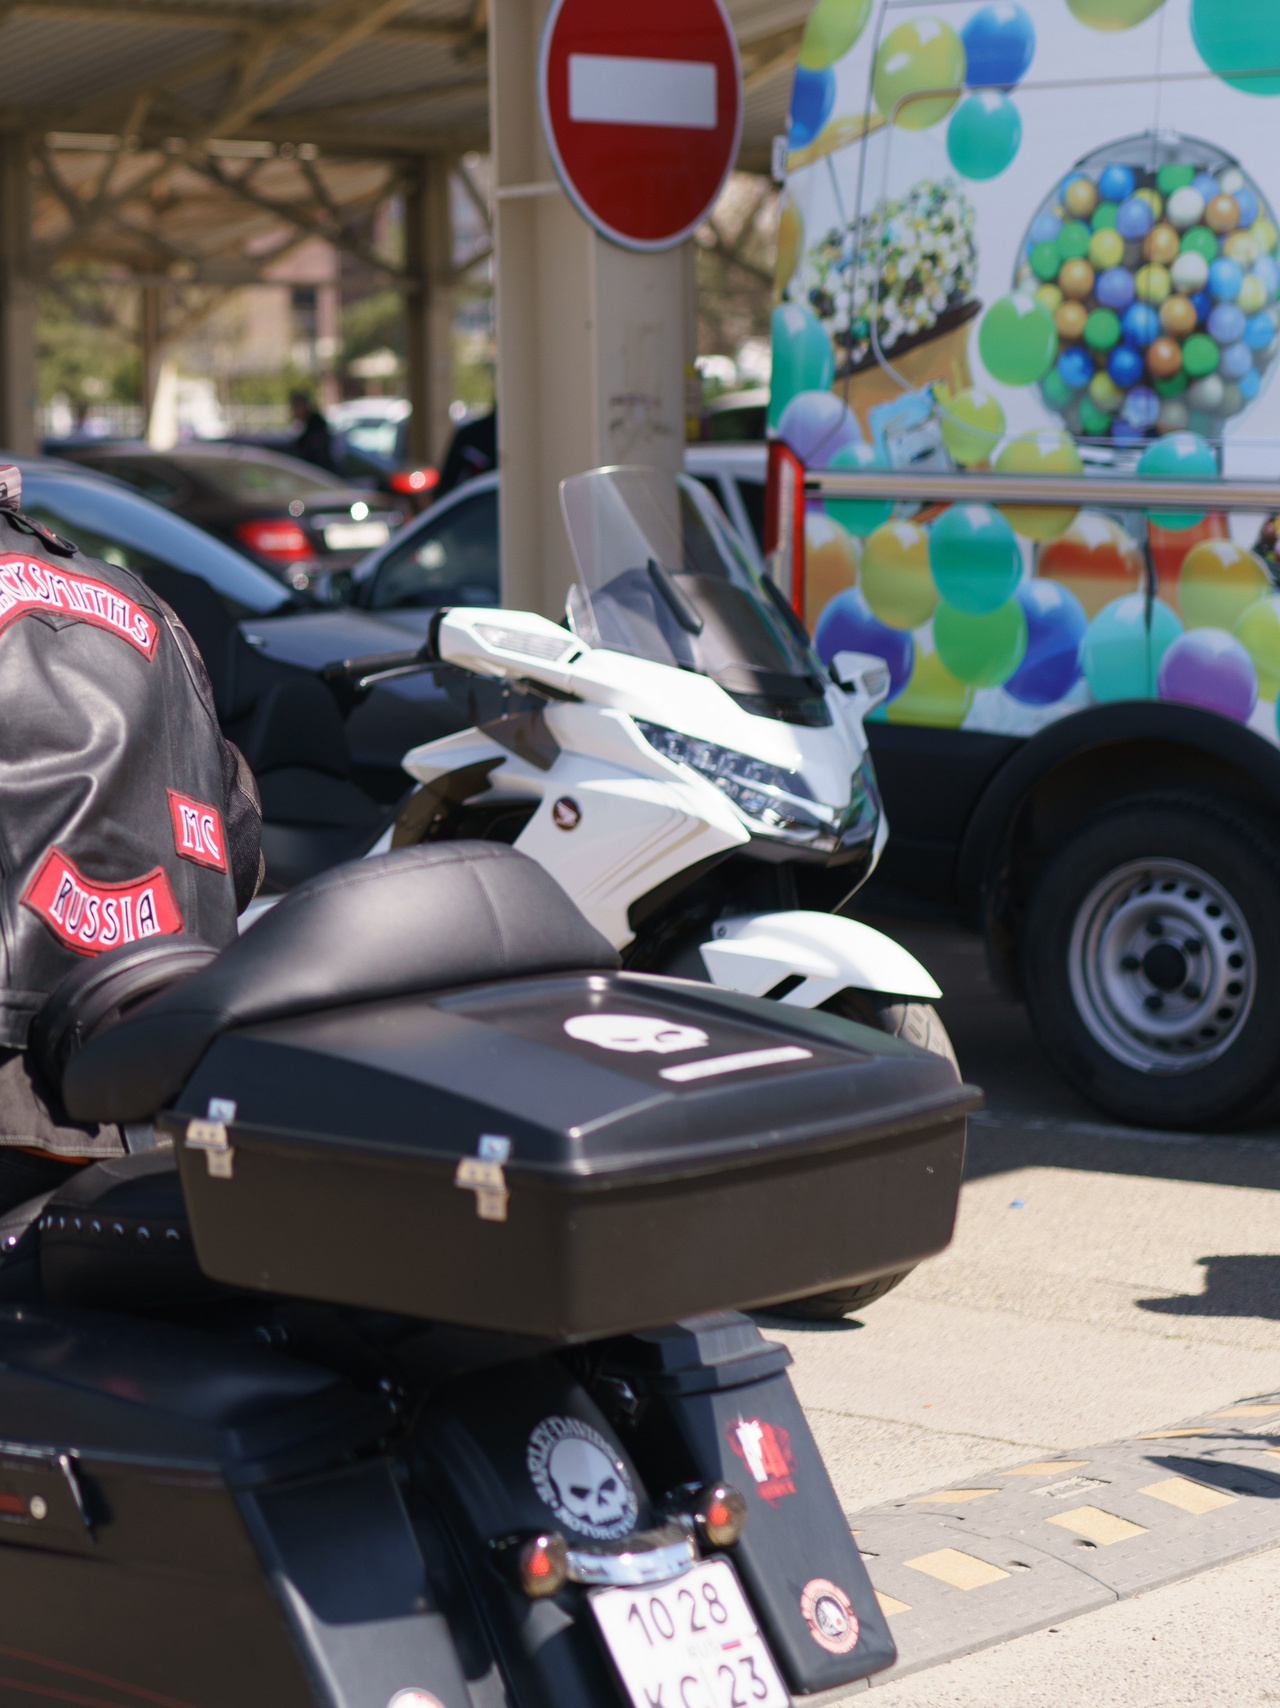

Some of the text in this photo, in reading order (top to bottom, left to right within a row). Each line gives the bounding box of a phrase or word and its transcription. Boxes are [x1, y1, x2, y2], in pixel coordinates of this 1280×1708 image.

[178, 804, 221, 860] MC
[48, 870, 161, 945] RUSSIA
[718, 1656, 768, 1708] 23
